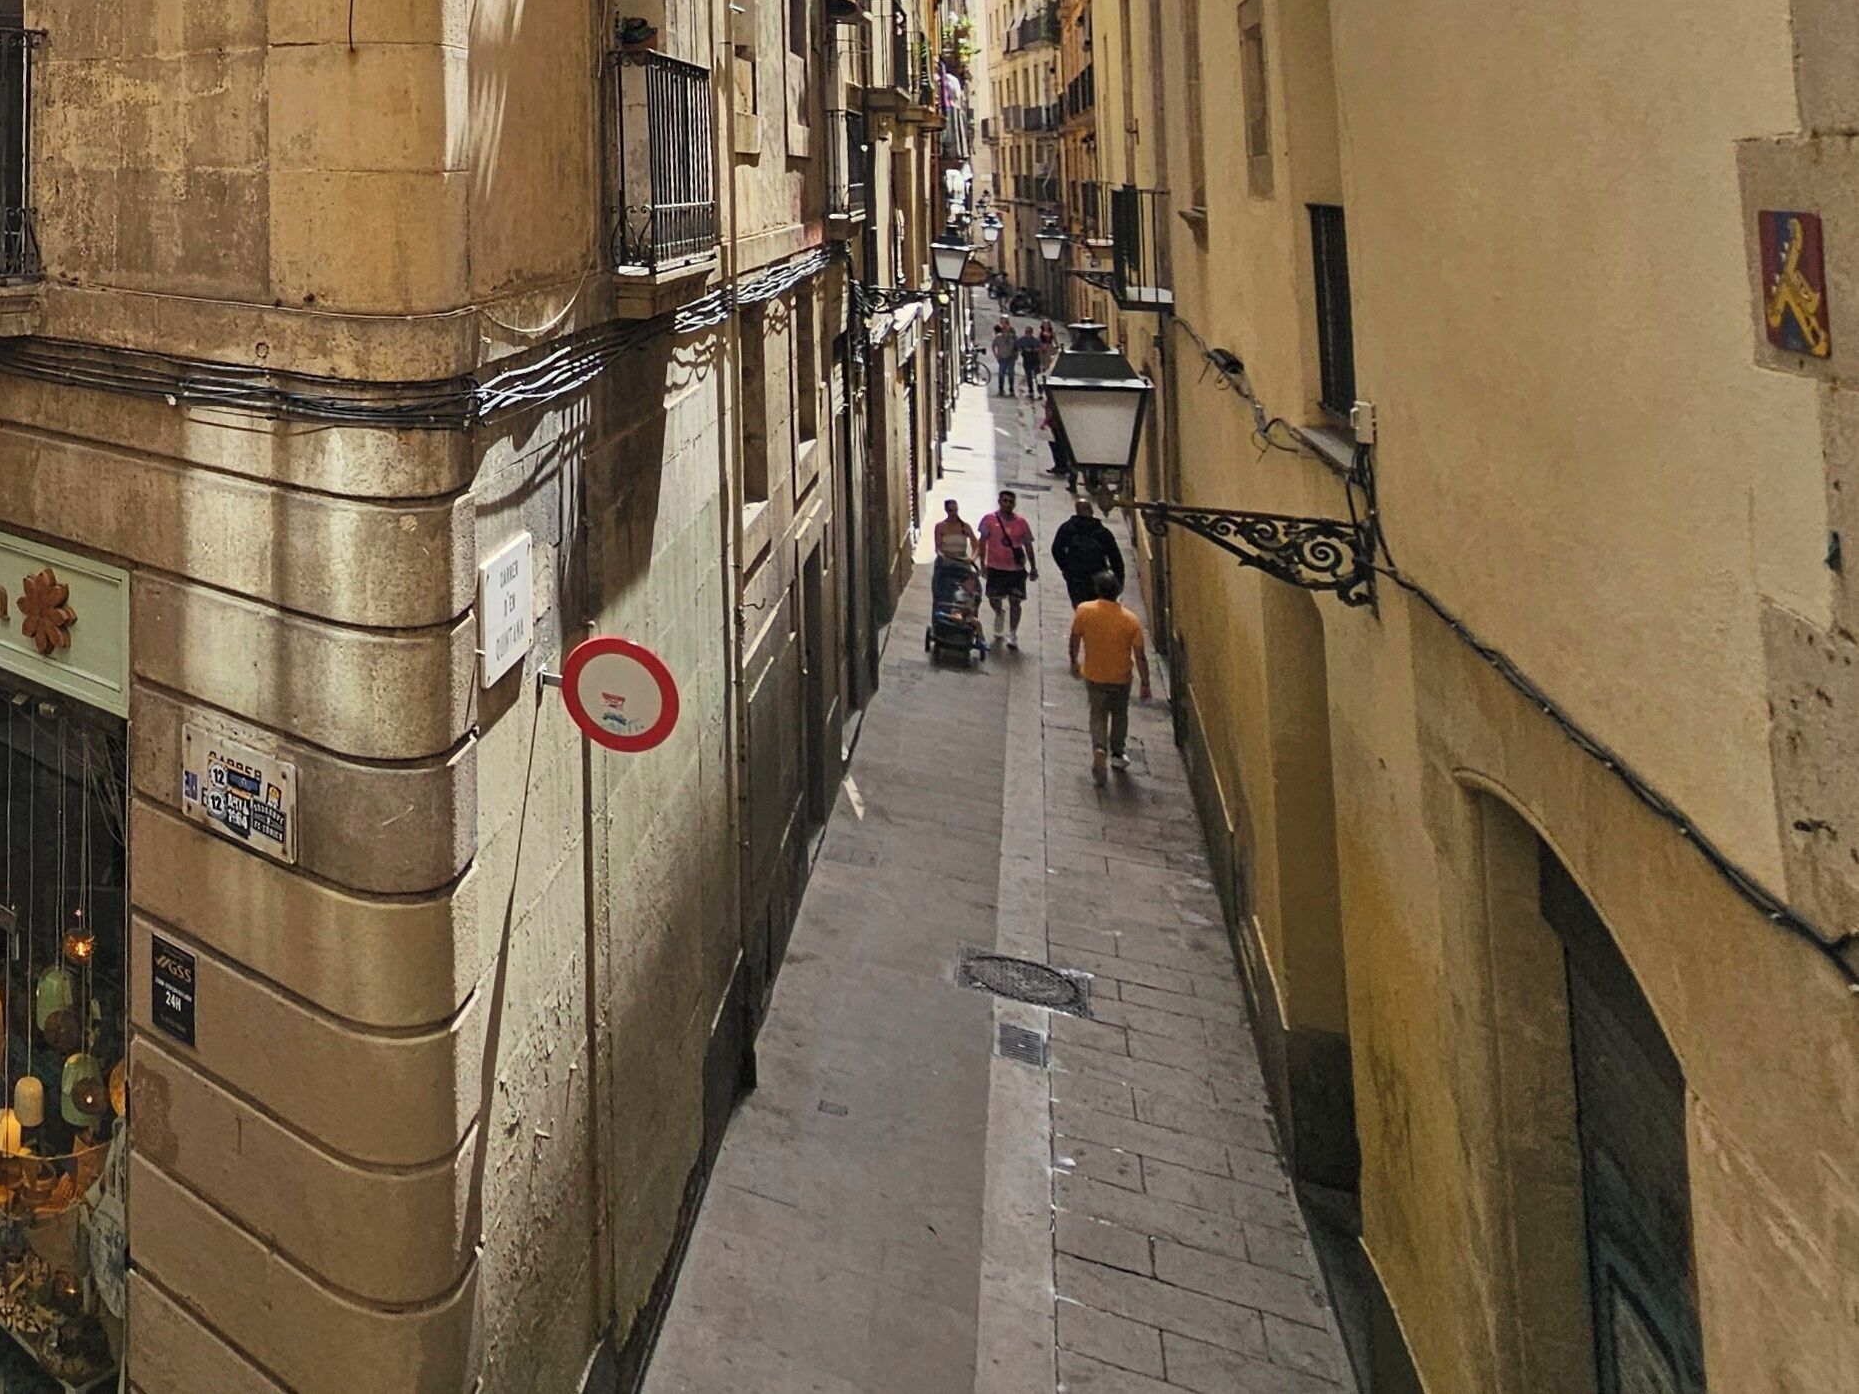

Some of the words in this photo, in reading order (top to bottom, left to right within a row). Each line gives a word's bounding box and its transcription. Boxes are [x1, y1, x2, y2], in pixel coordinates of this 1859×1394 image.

[213, 768, 225, 786] 12
[210, 795, 222, 812] 12
[165, 990, 182, 1012] 24H
